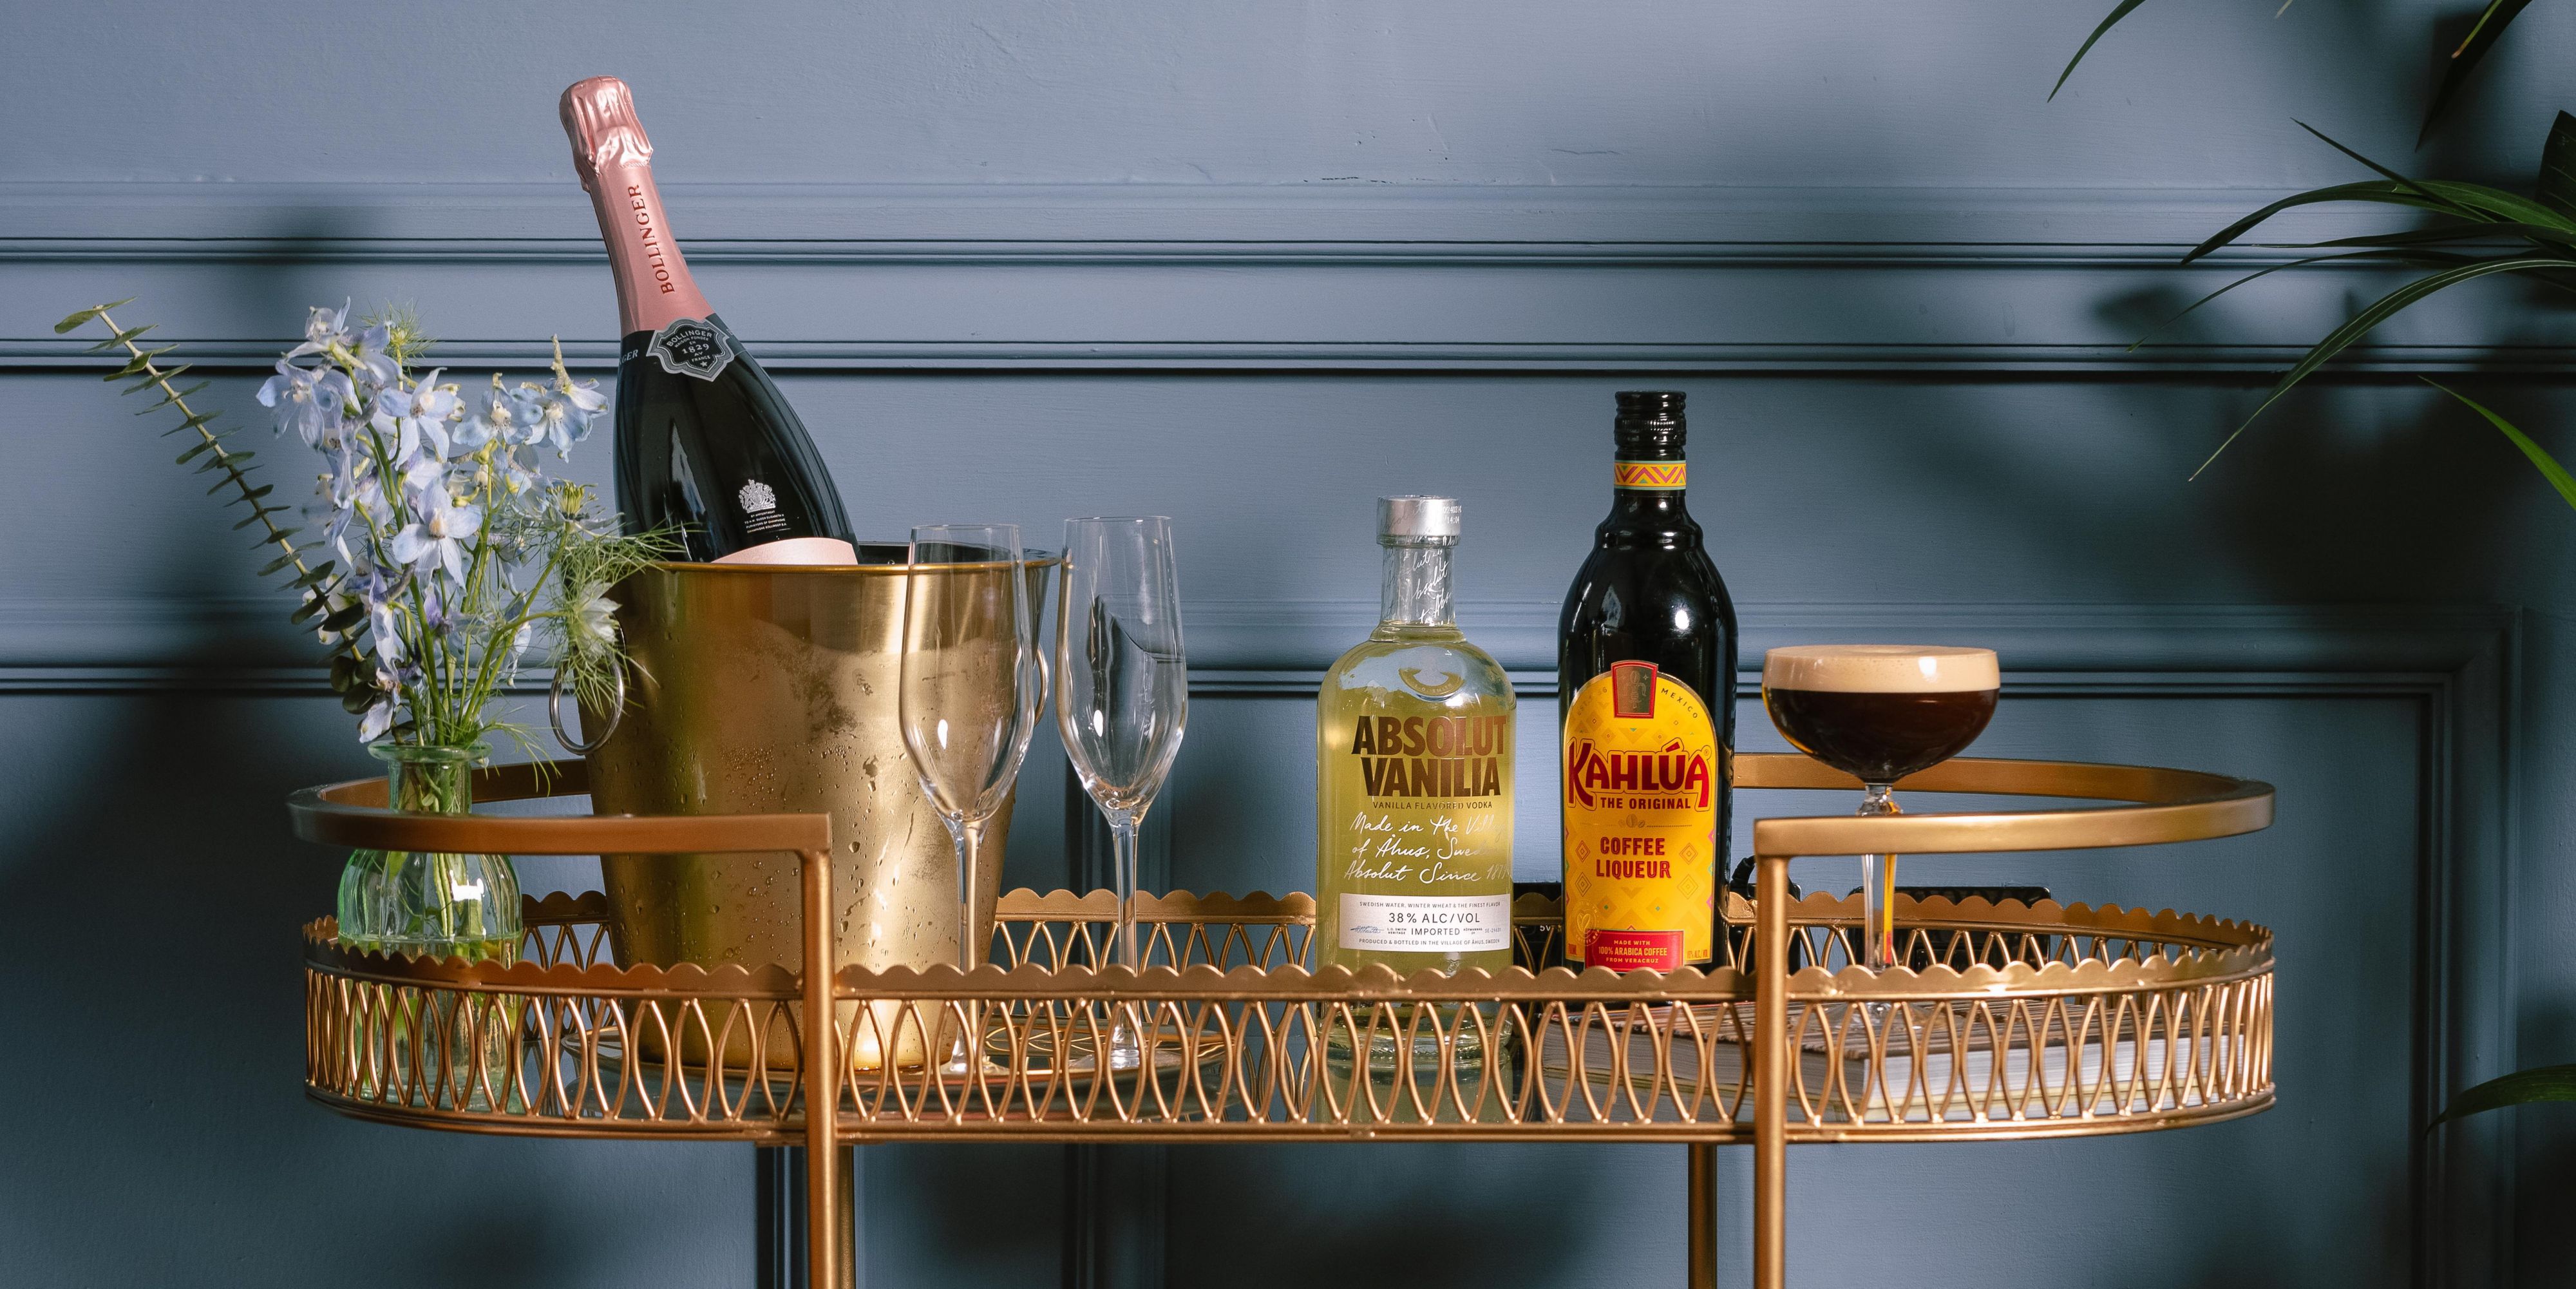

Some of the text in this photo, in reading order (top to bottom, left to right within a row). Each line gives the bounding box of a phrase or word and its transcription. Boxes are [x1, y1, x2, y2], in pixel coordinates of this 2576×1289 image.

[628, 184, 675, 294] BOLLINGER
[666, 329, 712, 347] BOLLINGER
[675, 337, 690, 348] MAISON
[681, 343, 709, 354] 1829
[1662, 687, 1698, 718] MEXICO
[1351, 715, 1507, 757] ABSOLUT
[1360, 756, 1501, 797] VANILIA
[1569, 741, 1709, 807] KAHLÚA
[1466, 801, 1493, 809] VODKA
[1600, 797, 1691, 809] THE ORIGINAL
[1349, 811, 1394, 835] Made
[1398, 820, 1424, 833] in
[1430, 815, 1459, 835] the
[1352, 837, 1371, 859] of
[1376, 834, 1430, 860] Åhus,
[1600, 837, 1665, 855] COFFEE
[1343, 859, 1413, 881] Absolut
[1419, 861, 1481, 884] Since
[1596, 859, 1671, 880] LIQUEUR
[1388, 912, 1481, 924] 38% ALC/VOL
[1598, 946, 1667, 957] 100% ARABICA COFFEE
